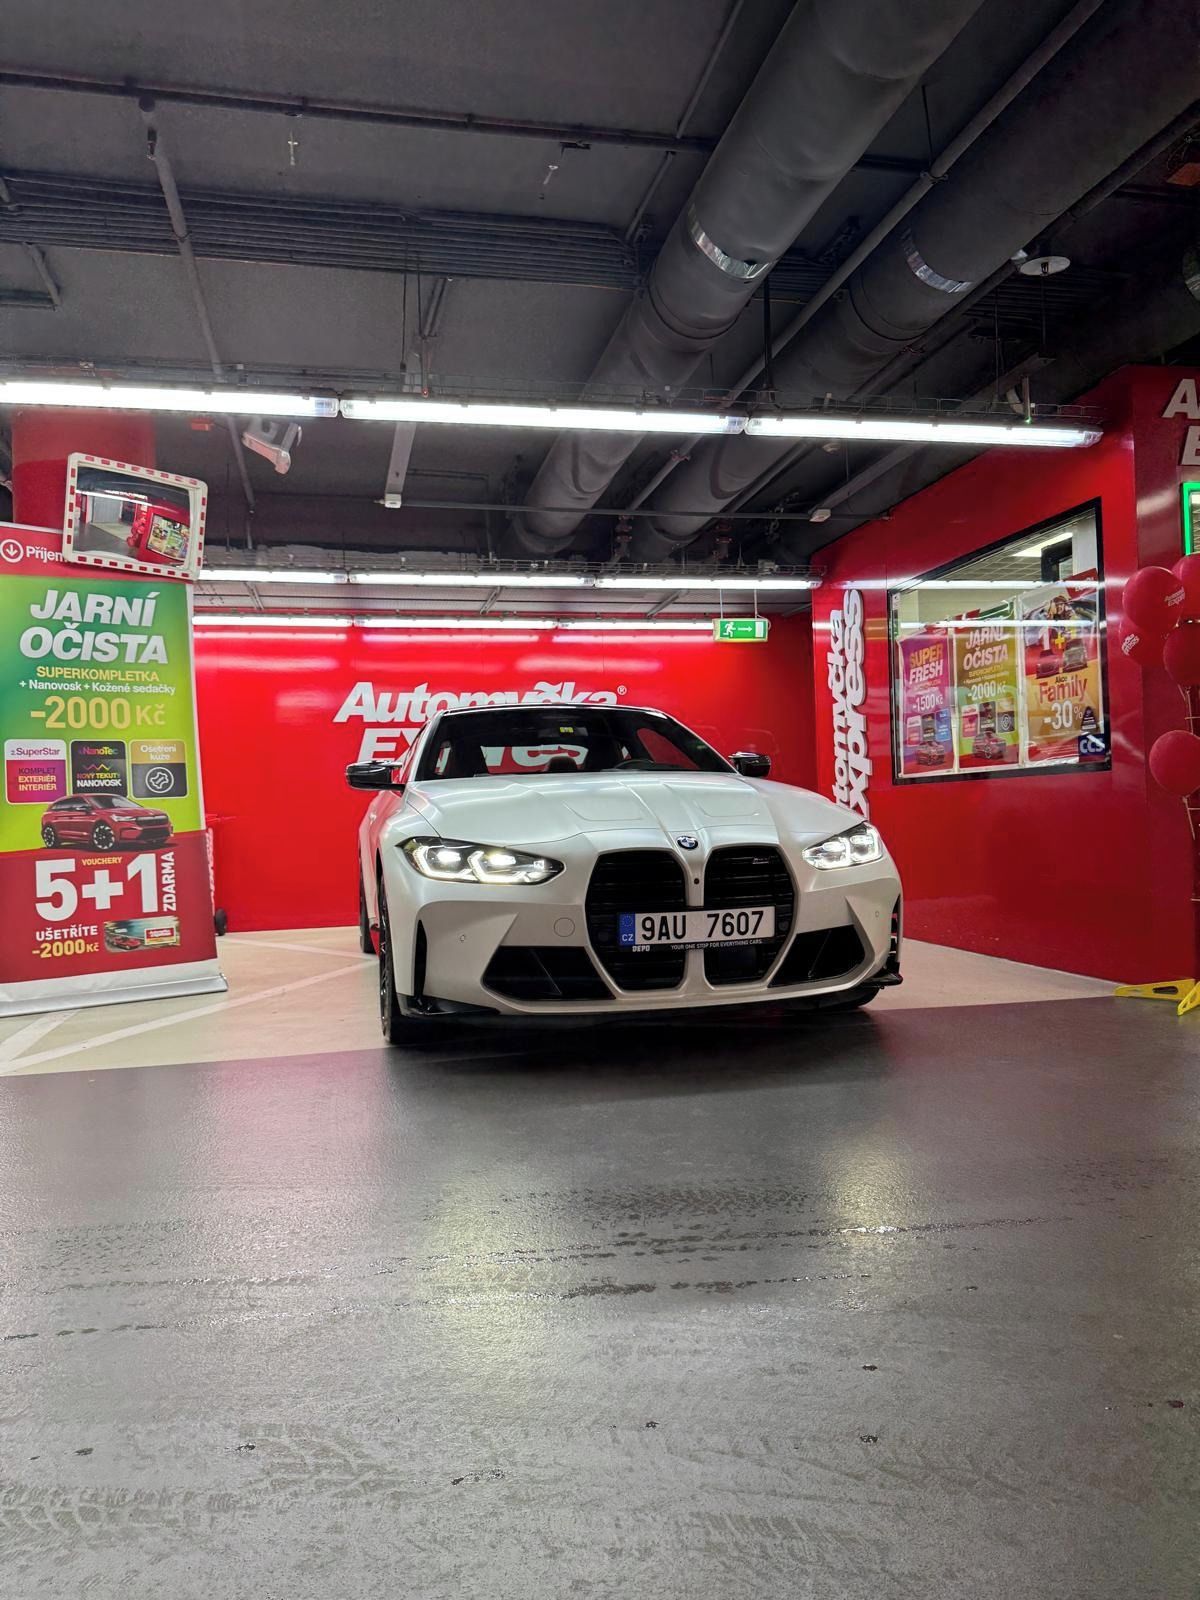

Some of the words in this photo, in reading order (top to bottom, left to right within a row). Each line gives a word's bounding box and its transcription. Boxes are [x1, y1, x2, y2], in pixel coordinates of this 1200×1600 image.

[30, 589, 160, 627] JARNÍ
[19, 622, 168, 664] OČISTA
[909, 643, 944, 669] SUPER
[963, 643, 1009, 671] OČISTA
[36, 666, 160, 681] SUPERKOMPLETKA
[909, 659, 944, 685] FRESH
[29, 680, 81, 692] Nanovosk
[92, 682, 130, 694] Kožené
[133, 683, 177, 696] sedačky
[968, 680, 996, 701] -2000
[1039, 675, 1088, 705] Family
[31, 696, 131, 729] -2000
[136, 704, 166, 725] Kč
[18, 767, 56, 775] KOMPLET
[77, 778, 122, 788] NANOVOSK
[82, 856, 123, 866] VOUCHERY
[35, 853, 158, 921] 5+1
[161, 851, 177, 912] ZDARMA
[35, 924, 98, 942] UŠETŘÍTE
[621, 933, 634, 942] CZ
[641, 914, 687, 941] 9AU
[707, 910, 764, 938] 7607
[32, 939, 86, 959] -2000
